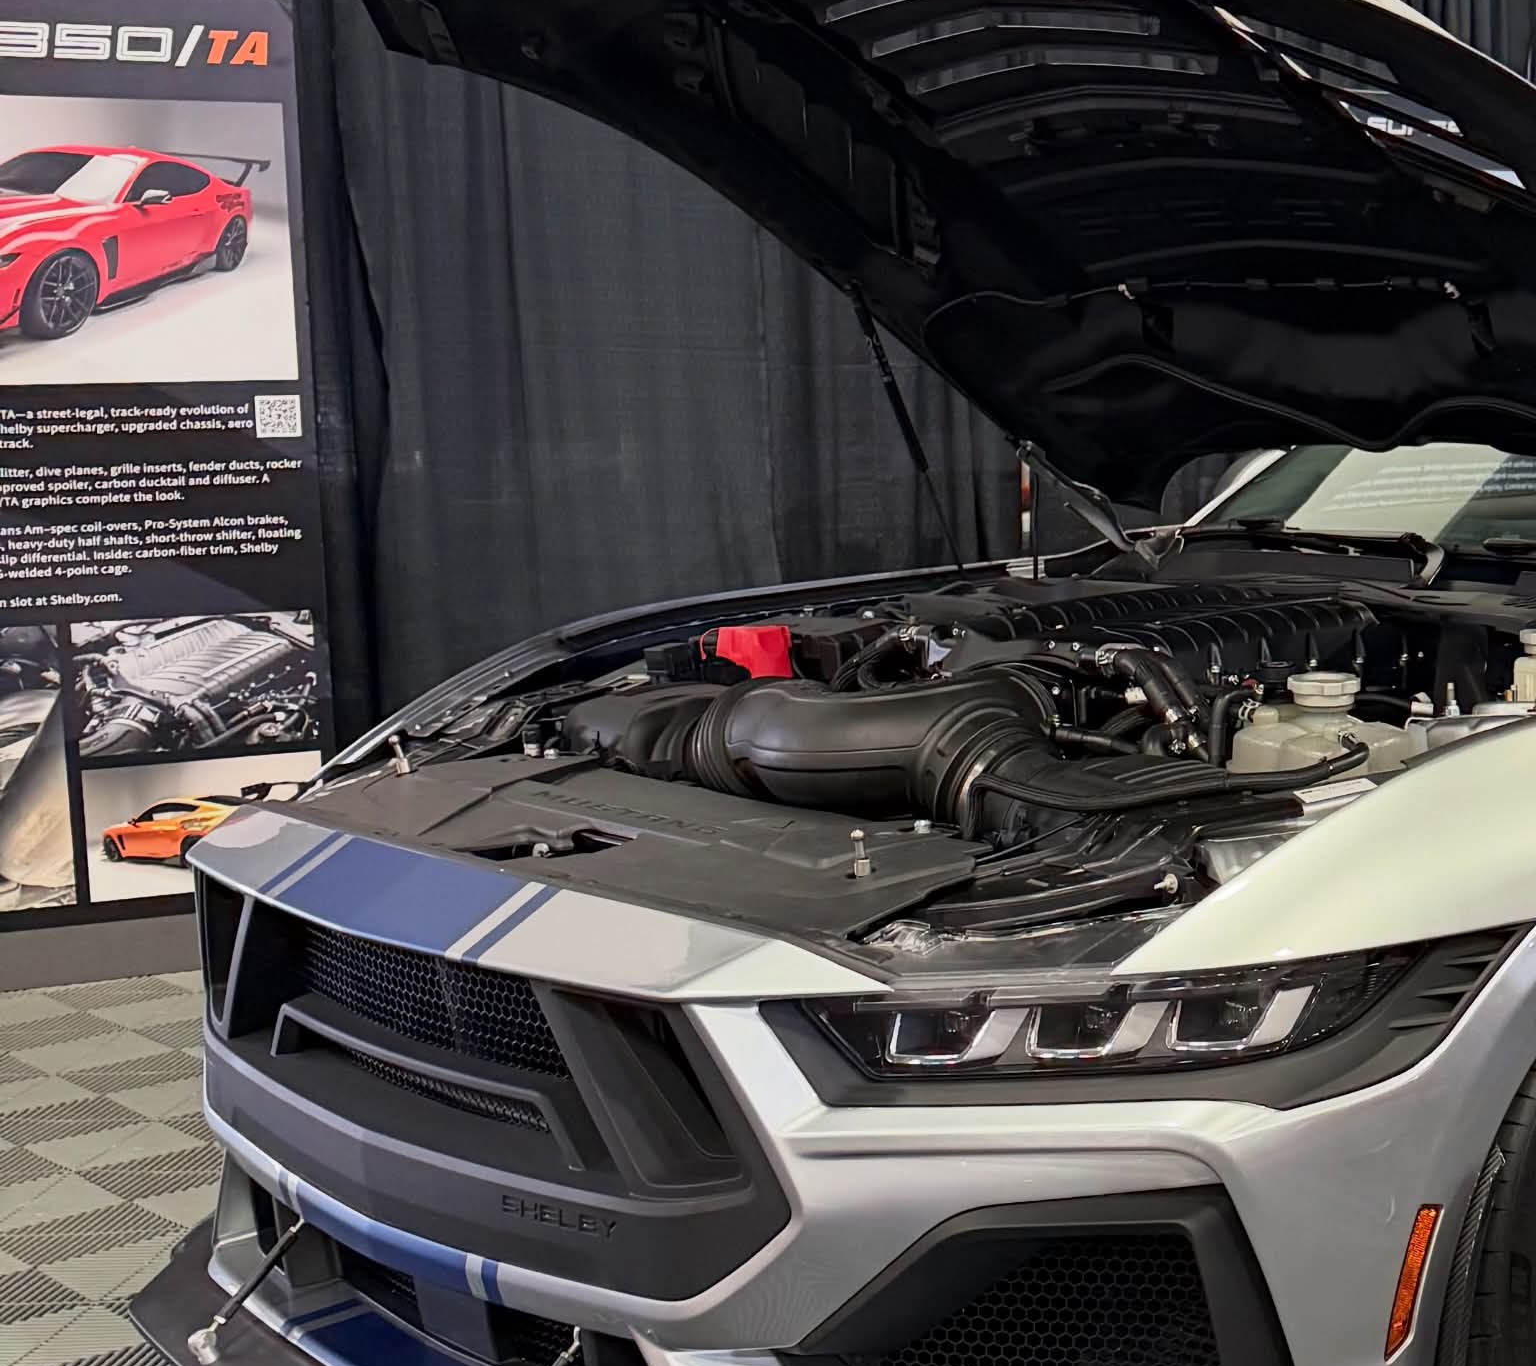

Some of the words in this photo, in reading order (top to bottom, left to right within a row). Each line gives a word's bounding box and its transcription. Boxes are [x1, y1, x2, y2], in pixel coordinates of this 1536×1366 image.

[37, 407, 108, 419] street-legal,
[111, 406, 177, 417] track-ready
[180, 404, 234, 415] evolution
[237, 403, 249, 414] of
[37, 422, 118, 435] supercharger,
[121, 420, 177, 432] upgraded
[180, 419, 225, 429] chassis,
[228, 420, 254, 428] aero
[0, 438, 33, 448] track.
[36, 467, 61, 476] dive
[64, 466, 108, 477] planes,
[111, 463, 140, 475] grille
[143, 463, 186, 473] inserts,
[189, 461, 226, 471] fender
[229, 460, 264, 471] ducts,
[266, 459, 302, 468] rocker
[48, 480, 92, 493] spoiler,
[95, 479, 136, 488] carbon
[139, 476, 185, 487] ducktail
[189, 475, 210, 485] and
[213, 474, 259, 484] diffuser.
[262, 474, 270, 483] A
[22, 495, 73, 508] graphics
[76, 492, 131, 505] complete
[134, 491, 152, 501] the
[156, 491, 184, 501] look.
[0, 527, 21, 535] ans
[81, 522, 142, 532] coil-overs,
[145, 519, 210, 530] Pro-System
[213, 517, 244, 526] Alcon
[247, 515, 288, 525] brakes,
[8, 538, 75, 550] heavy-duty
[78, 536, 101, 547] half
[104, 535, 142, 545] shafts,
[146, 532, 213, 543] short-throw
[216, 530, 255, 540] shifter,
[258, 528, 302, 539] floating
[20, 552, 90, 563] differential.
[94, 549, 132, 560] Inside:
[136, 546, 206, 558] carbon-fiber
[210, 545, 237, 555] trim,
[240, 543, 278, 554] Shelby
[55, 565, 98, 577] 4-point
[101, 565, 132, 575] cage.
[10, 597, 32, 607] slot
[36, 597, 47, 605] at
[50, 594, 122, 605] Shelby.com.
[502, 1194, 617, 1238] SHELBY
